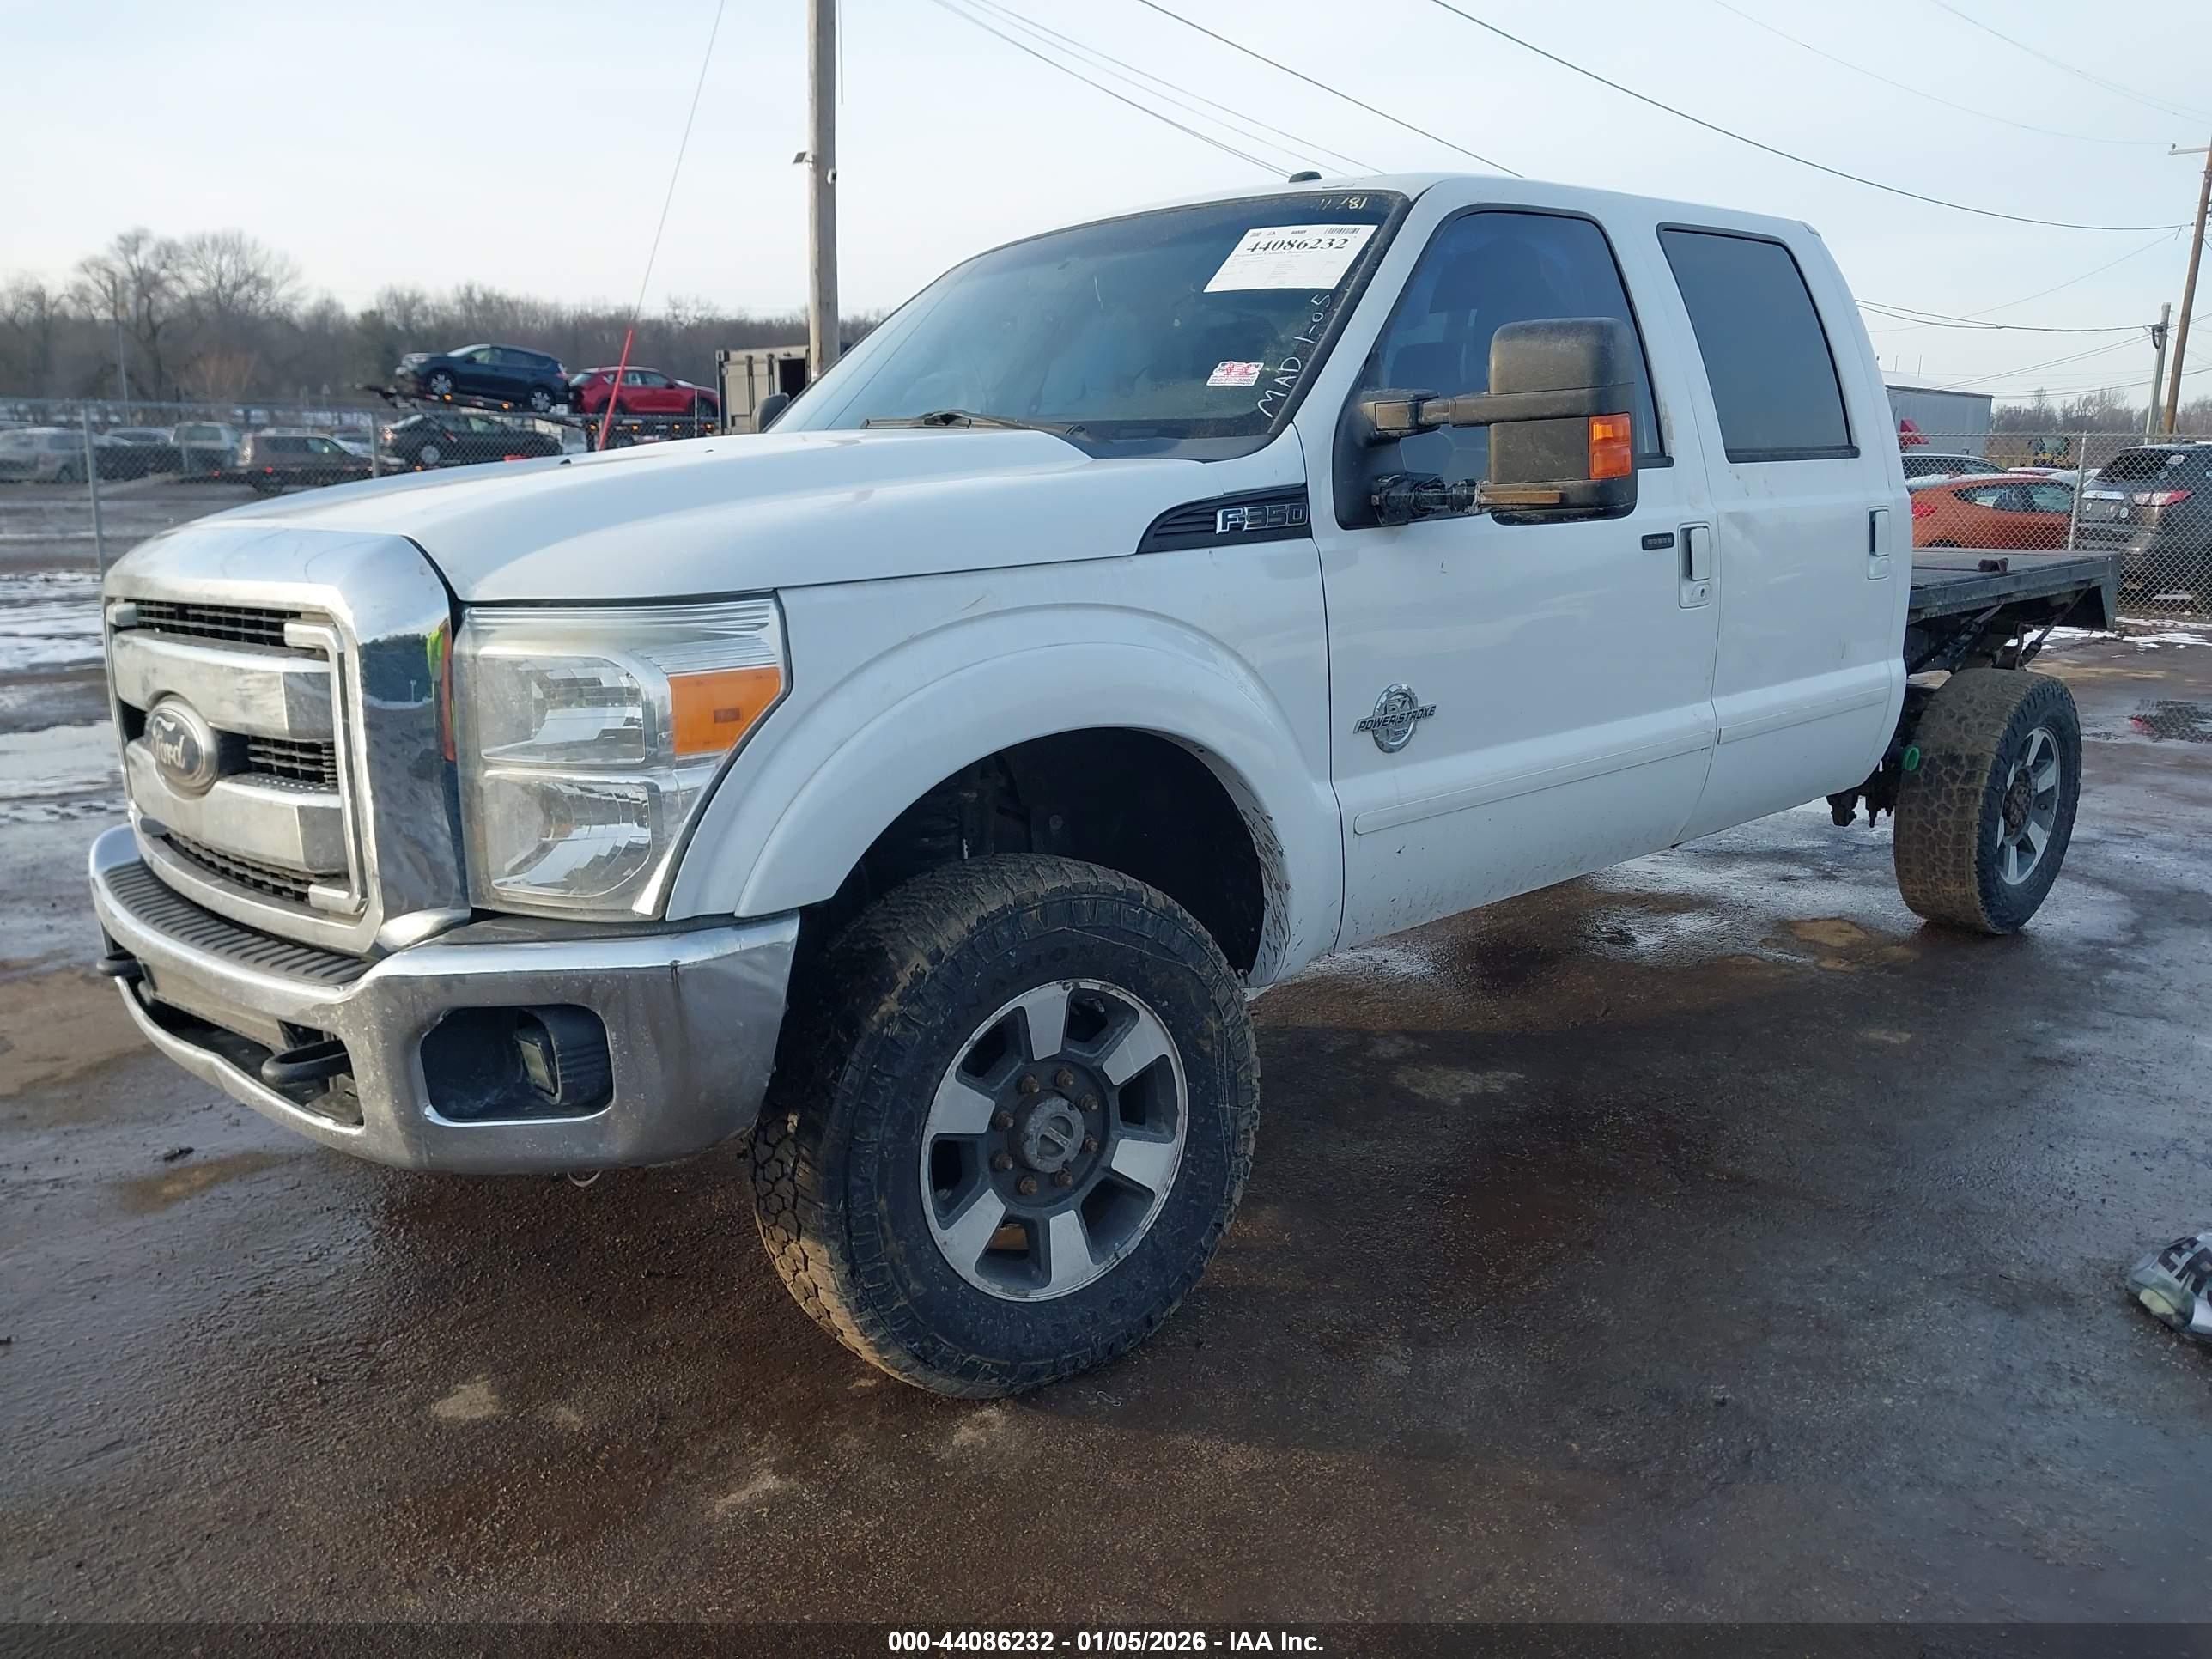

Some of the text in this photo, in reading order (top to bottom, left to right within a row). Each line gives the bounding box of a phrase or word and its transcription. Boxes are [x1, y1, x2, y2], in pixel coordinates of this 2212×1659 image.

[1246, 236, 1349, 252] 44086232
[1257, 356, 1302, 418] MAD
[1357, 704, 1437, 732] POWER STROKE
[150, 715, 187, 769] Ford
